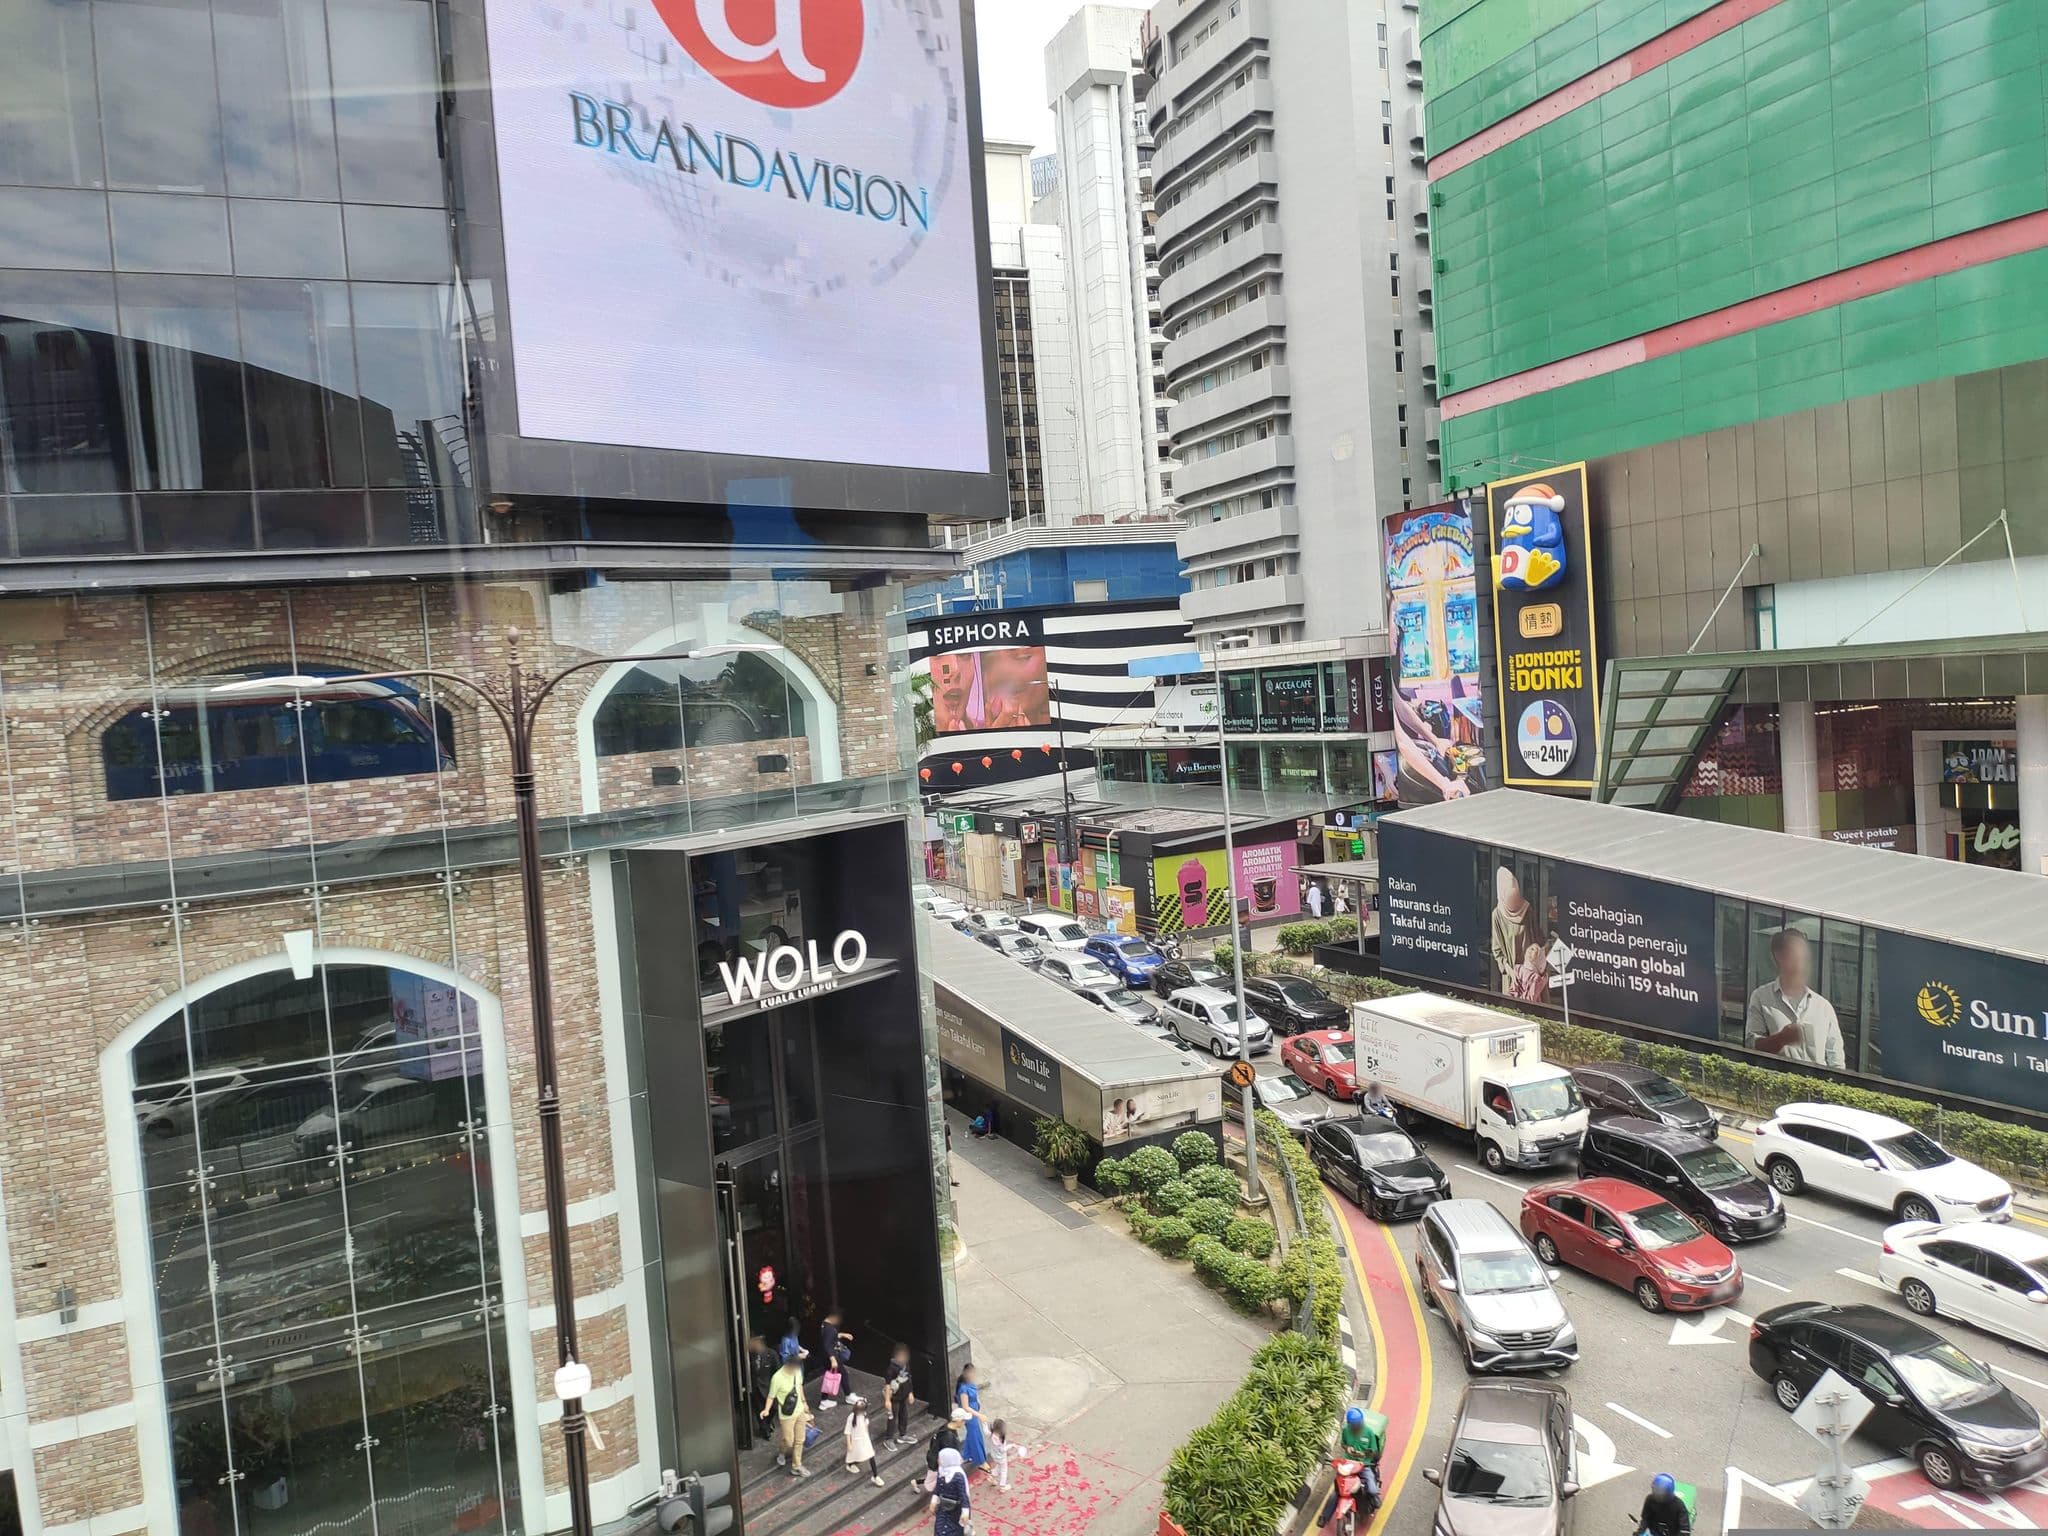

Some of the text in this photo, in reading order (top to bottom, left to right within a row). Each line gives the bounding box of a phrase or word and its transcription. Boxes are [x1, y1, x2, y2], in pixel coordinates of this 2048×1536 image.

[568, 92, 929, 232] BRANDAVISION
[934, 620, 1030, 645] SEPHORA
[1516, 666, 1582, 692] DONKI
[1350, 677, 1359, 715] ACCEA
[1373, 674, 1384, 714] ACCEA
[1523, 743, 1569, 763] OPEN 24hr
[1833, 828, 1898, 840] Sweet potato
[1242, 846, 1282, 859] AROMATIK
[1243, 854, 1282, 867] AROMATIK
[1243, 863, 1283, 875] AROMATIK
[1388, 876, 1417, 892] Rakan
[1389, 895, 1451, 916] Insurans dan
[1568, 901, 1643, 926] Sebahagian
[1390, 912, 1452, 935] Takaful anda
[1391, 934, 1469, 958] yang dipercayai
[1569, 922, 1688, 957] daripada peneraju
[717, 929, 868, 1005] WOLO
[1570, 943, 1685, 978] kewangan global
[760, 980, 840, 1009] KUALA LUMPUR
[1572, 967, 1699, 1003] melebihi 159 tahun
[1970, 999, 2038, 1038] Sun
[1942, 1039, 2005, 1065] Insurans
[1021, 1052, 1051, 1079] Sun Life
